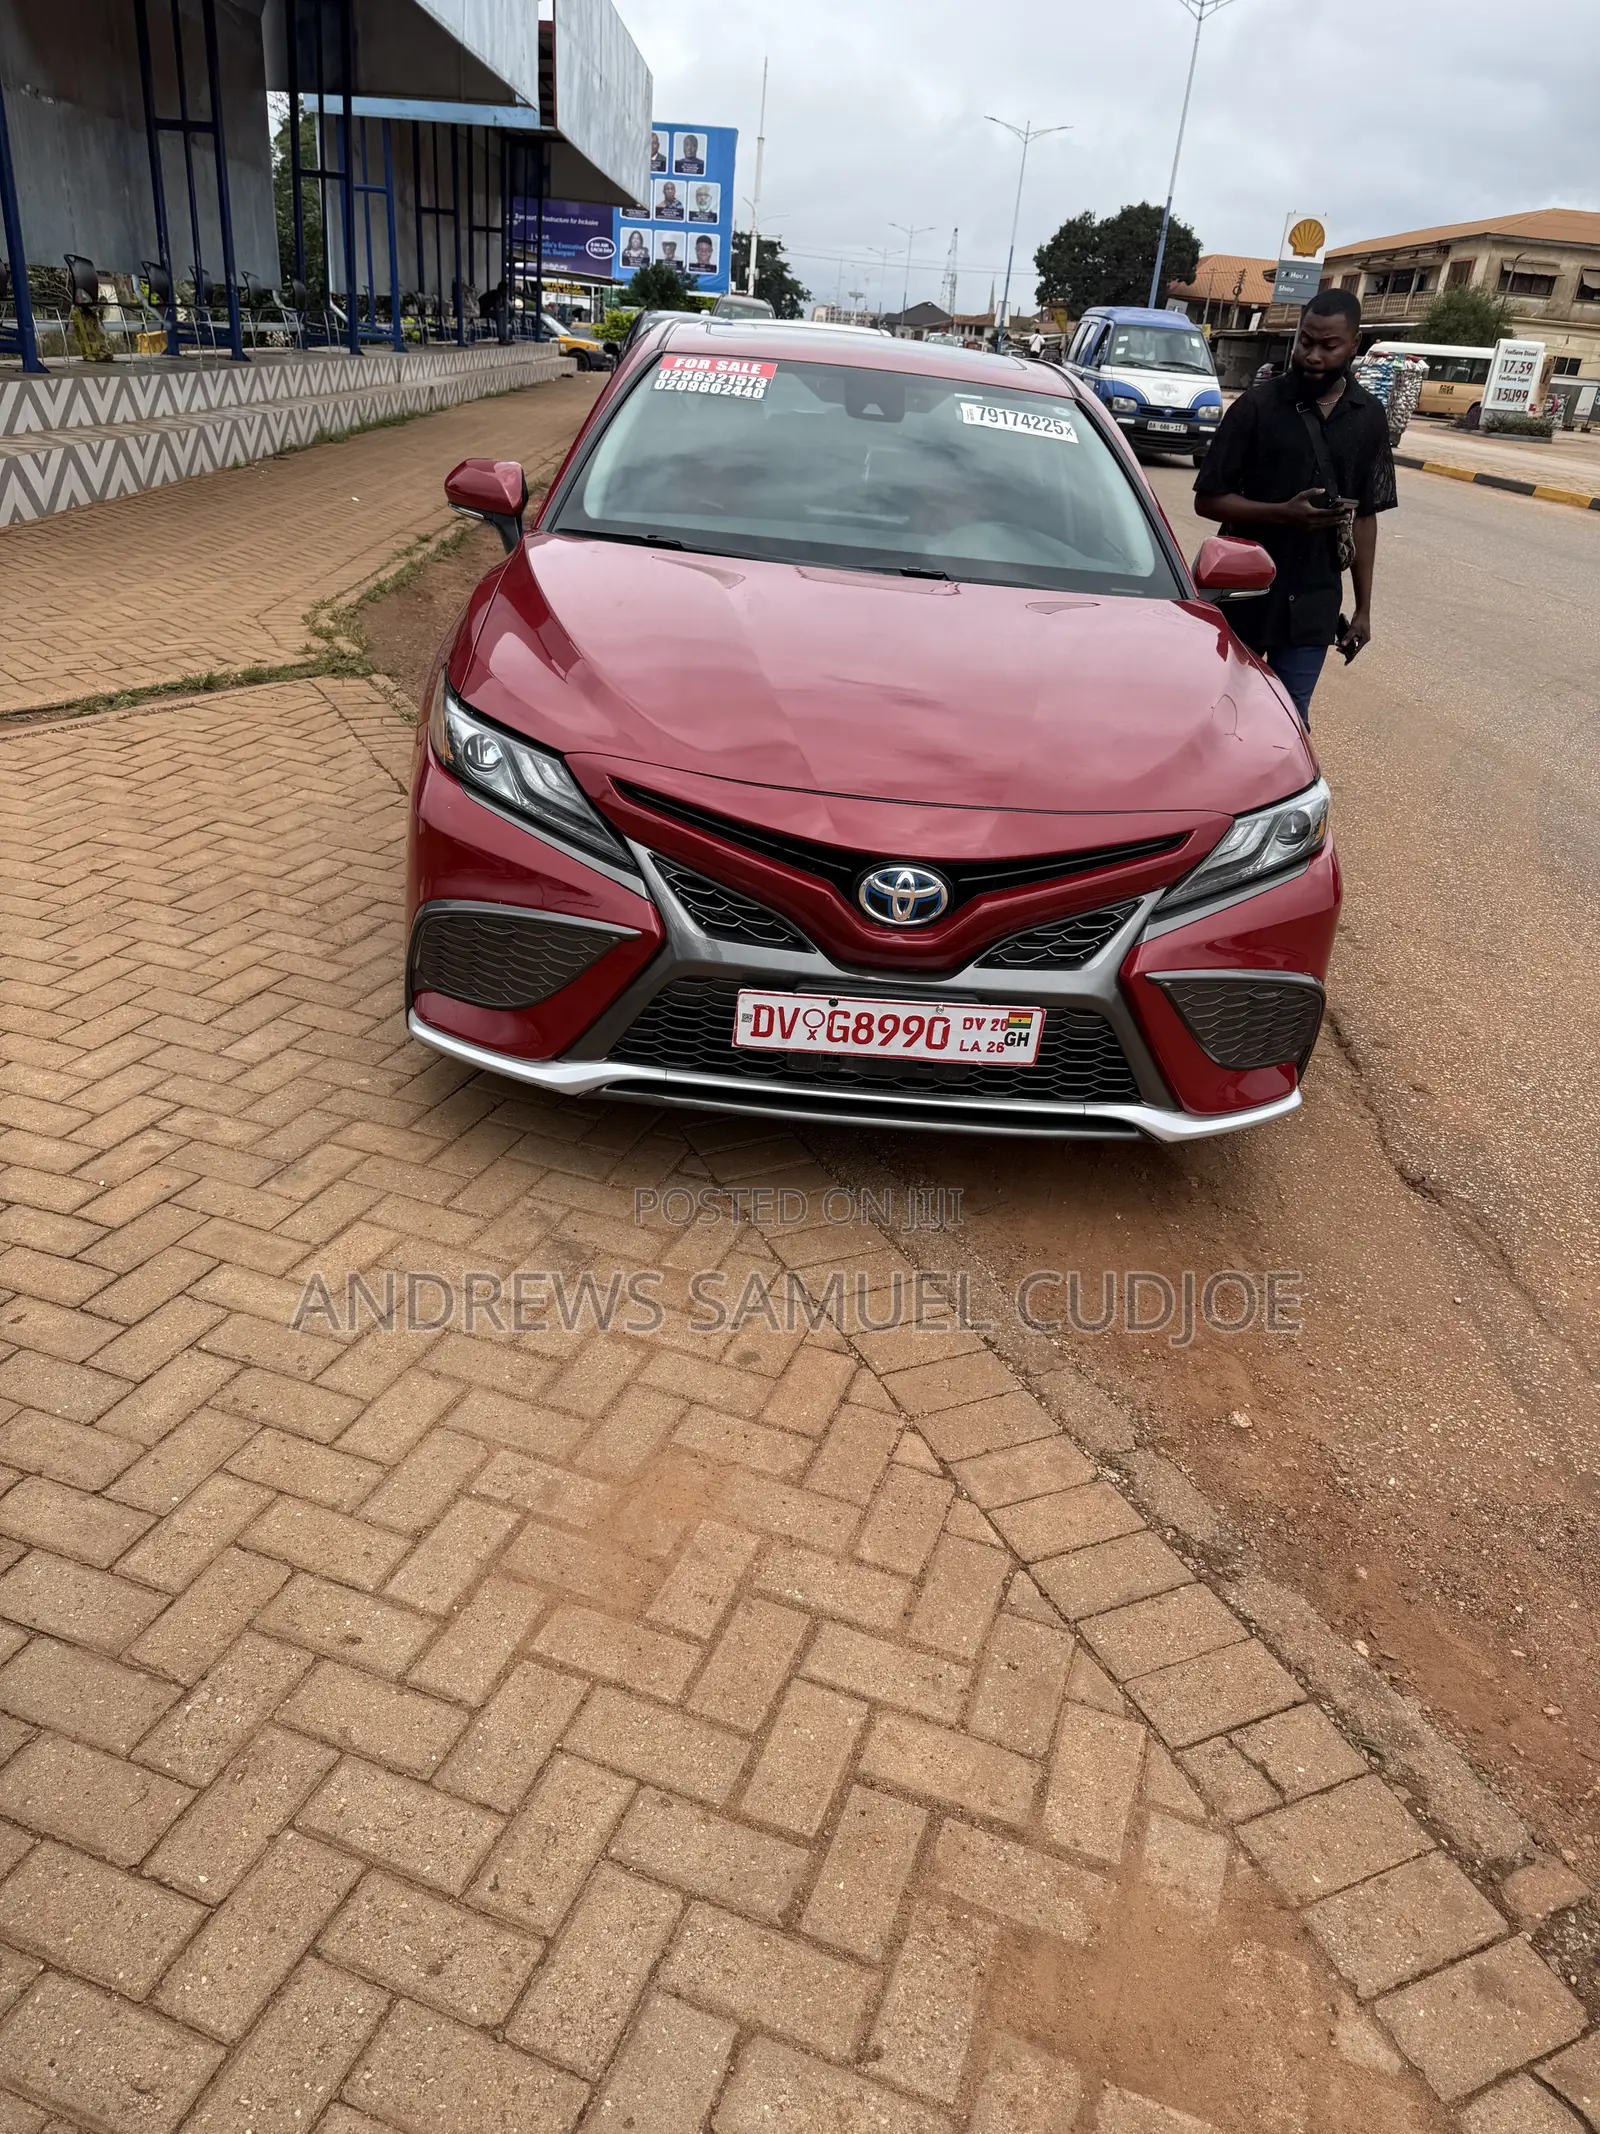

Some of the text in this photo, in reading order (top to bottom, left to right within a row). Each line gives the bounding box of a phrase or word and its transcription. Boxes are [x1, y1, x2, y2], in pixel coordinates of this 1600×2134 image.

[1278, 285, 1295, 293] Shop
[1524, 349, 1538, 357] Diesel
[674, 358, 763, 375] FOR SALE
[1503, 360, 1533, 375] 17.59
[658, 369, 768, 389] 0256321573
[1517, 376, 1530, 384] Super
[654, 379, 765, 399] 0209802440
[750, 1003, 951, 1051] DV G8990
[962, 1016, 987, 1031] DV
[959, 1039, 1006, 1054] LA 26
[1004, 1031, 1030, 1048] GH
